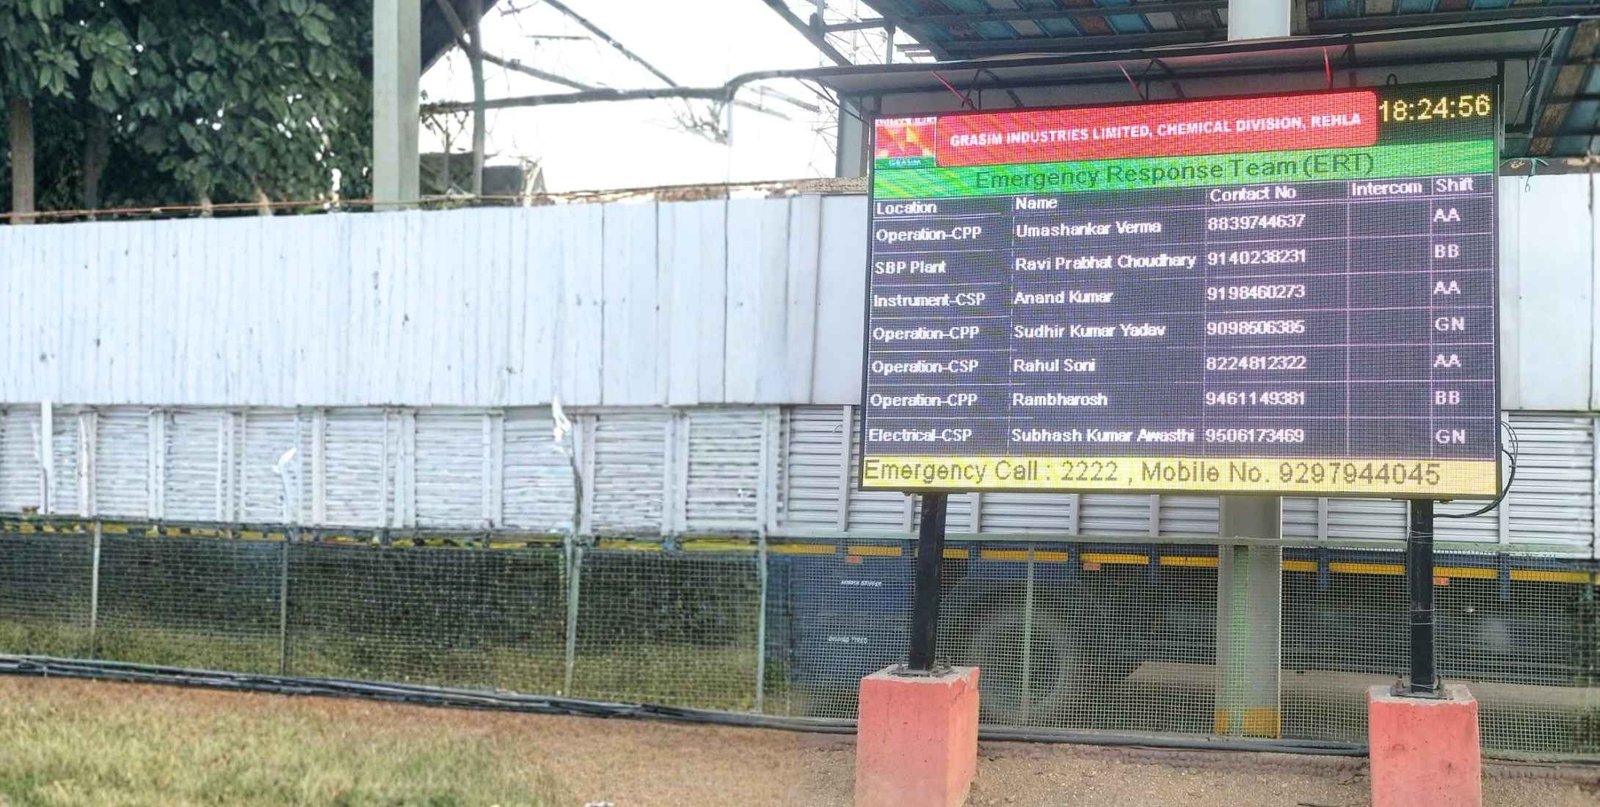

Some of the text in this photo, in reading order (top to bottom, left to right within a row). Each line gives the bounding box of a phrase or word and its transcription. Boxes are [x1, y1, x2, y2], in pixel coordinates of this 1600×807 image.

[1379, 93, 1491, 123] 18:24:56
[950, 113, 1361, 147] GRASIM INDUSTRIES LIMITED, CHEMICAL DIVISION, REHLA
[975, 152, 1374, 190] Emergency Response Team (ERT)
[1352, 182, 1422, 196] Intercom
[1435, 177, 1474, 192] Shift
[1210, 186, 1297, 202] Contact No
[876, 201, 937, 215] Location
[1015, 196, 1058, 210] Name
[1207, 213, 1306, 231] 8839744637
[1433, 207, 1461, 222] AA
[876, 226, 982, 244] Operation-CPP
[1016, 220, 1162, 238] Umashankar Verma
[1207, 249, 1306, 266] 9140238231
[1434, 243, 1460, 258] BB
[875, 260, 947, 275] SBP Plant
[1015, 253, 1197, 271] Ravi Prabhat Choudhary
[1206, 284, 1306, 301] 9198460273
[1433, 280, 1461, 295] AA
[873, 292, 986, 308] Instrument-CSP
[1014, 289, 1114, 305] Anand Kumar
[1014, 321, 1167, 339] Sudhir Kumar Yadav
[1206, 319, 1306, 336] 9098506385
[1434, 316, 1465, 331] GN
[872, 326, 980, 343] Operation-CPP
[871, 359, 979, 377] Operation-CSP
[1013, 357, 1097, 373] Rahul Soni
[1206, 355, 1307, 371] 8224812322
[1433, 353, 1462, 368] AA
[870, 393, 978, 410] Operation-CPP
[1012, 392, 1109, 407] Rambharosh
[1205, 390, 1306, 406] 9461149381
[1434, 390, 1461, 405] BB
[868, 428, 973, 442] Electrical-CSP
[1011, 428, 1195, 443] Subhash Kumar Awasthi
[1205, 428, 1305, 443] 9506173469
[1435, 429, 1466, 444] GN
[864, 459, 987, 485] Emergency
[994, 460, 1038, 481] Call
[1060, 460, 1119, 482] 2222
[1141, 460, 1220, 483] Mobile
[1228, 461, 1271, 484] No.
[1278, 462, 1441, 486] 9297944045
